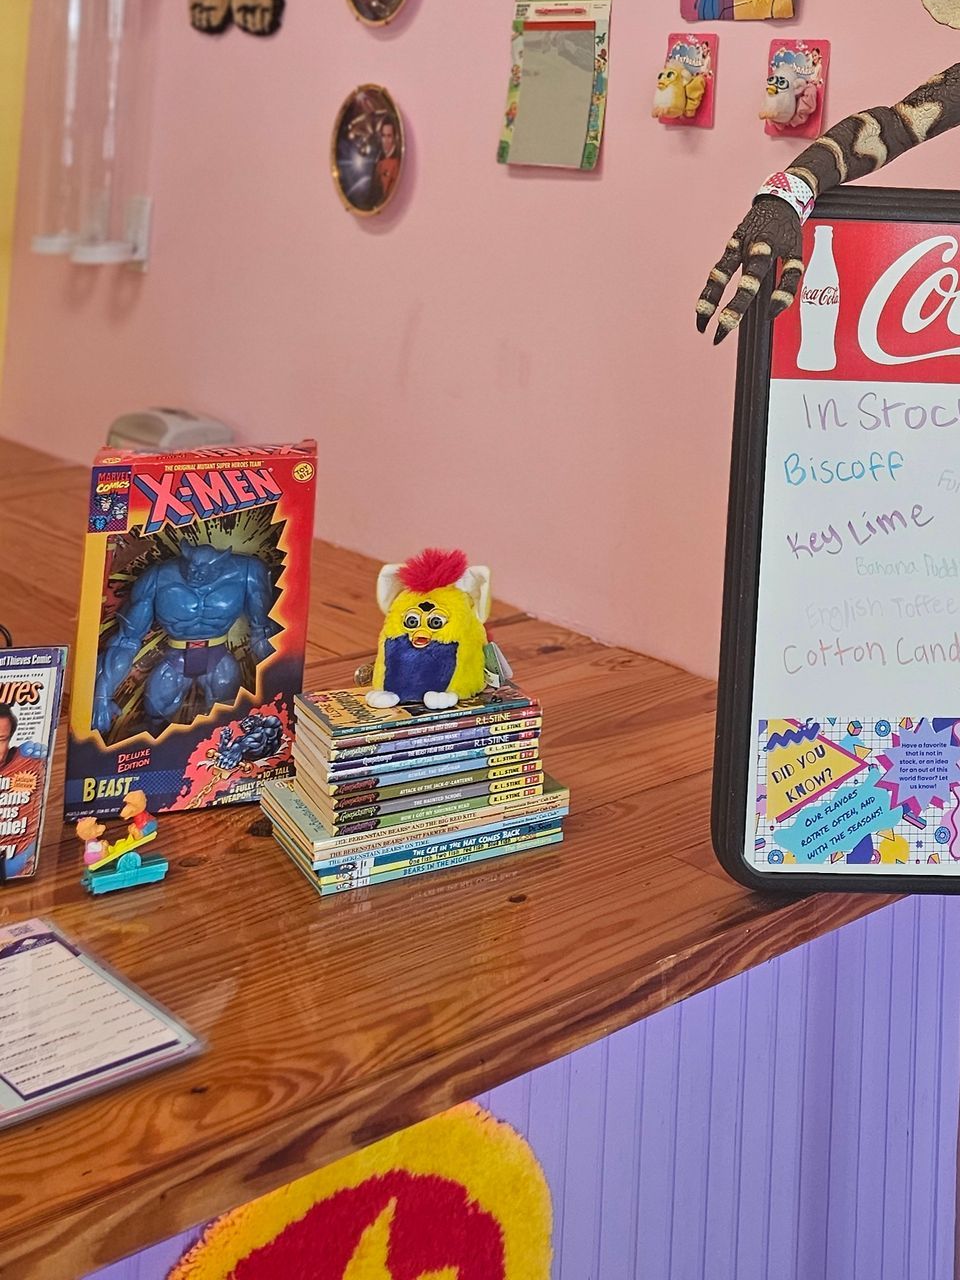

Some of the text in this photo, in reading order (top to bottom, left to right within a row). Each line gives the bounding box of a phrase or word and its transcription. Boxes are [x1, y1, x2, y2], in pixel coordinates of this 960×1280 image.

[803, 393, 847, 431] In
[98, 472, 131, 482] MARVEL
[164, 464, 173, 472] THE
[173, 463, 197, 471] ORIGINAL
[295, 464, 309, 475] TOY
[299, 472, 312, 481] BIZ
[784, 451, 904, 486] Biscoff
[96, 480, 130, 493] COMICS
[133, 468, 284, 534] X-MEN
[787, 504, 935, 560] Key Lime
[806, 594, 958, 633] English Toffee
[6, 655, 31, 666] Thieves
[31, 654, 52, 665] Comic
[784, 637, 886, 675] Cotton
[117, 759, 150, 773] EDITION
[118, 748, 151, 764] DELUXE
[771, 744, 826, 784] DID YOU
[83, 777, 132, 802] BEAST
[400, 787, 416, 795] ATTACK
[785, 767, 833, 803] KNOW?
[804, 789, 858, 827] OUR FLAVORS
[801, 796, 876, 847] ROTATE OFTEN, AND
[807, 806, 884, 860] WITH THE SEASONS!
[343, 842, 382, 856] BERENSTAIN
[422, 829, 447, 838] FARMER
[426, 845, 439, 854] CAT
[463, 838, 476, 847] HAT
[478, 833, 501, 843] COMES
[502, 829, 521, 839] BACK
[403, 866, 425, 875] BEARS
[437, 860, 449, 868] THE
[450, 855, 471, 865] NIGHT
